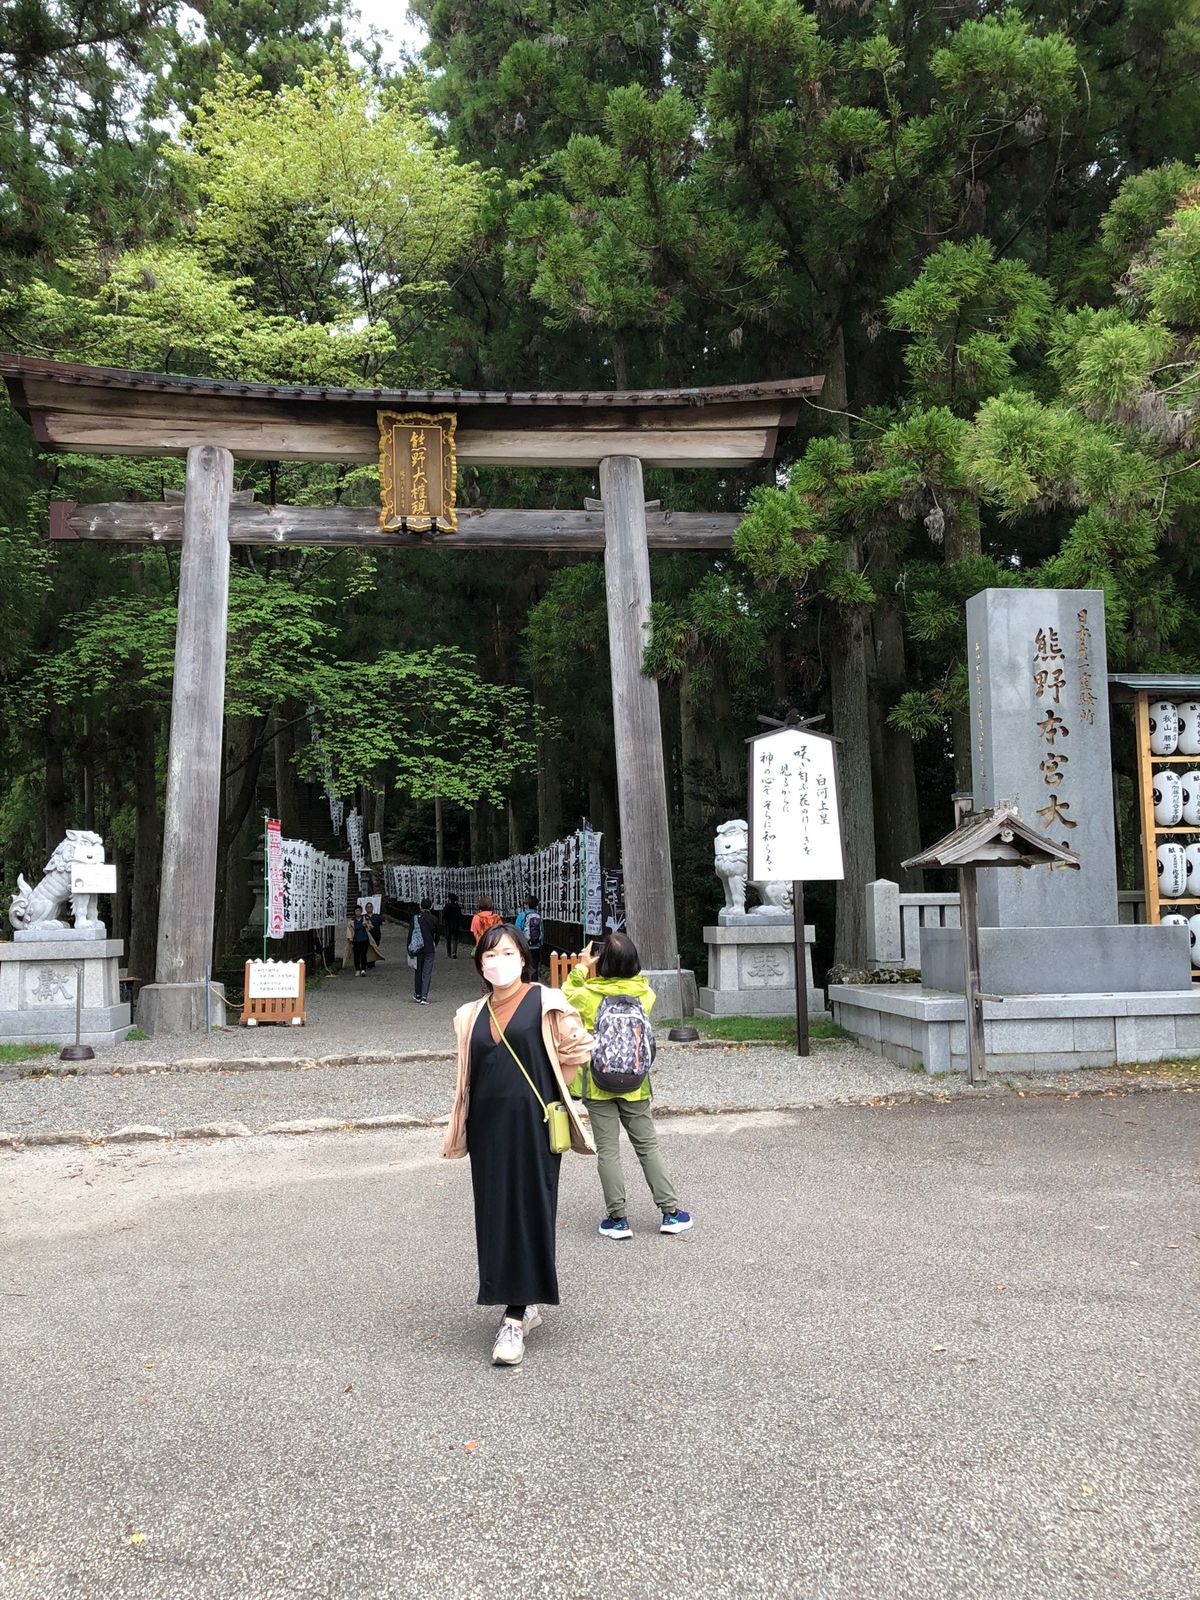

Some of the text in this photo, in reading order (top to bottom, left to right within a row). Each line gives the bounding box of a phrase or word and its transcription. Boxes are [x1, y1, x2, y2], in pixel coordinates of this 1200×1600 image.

[1033, 627, 1081, 872] 熊野本宮大
[779, 763, 792, 812] 見るからに
[815, 773, 830, 825] 白河上皇
